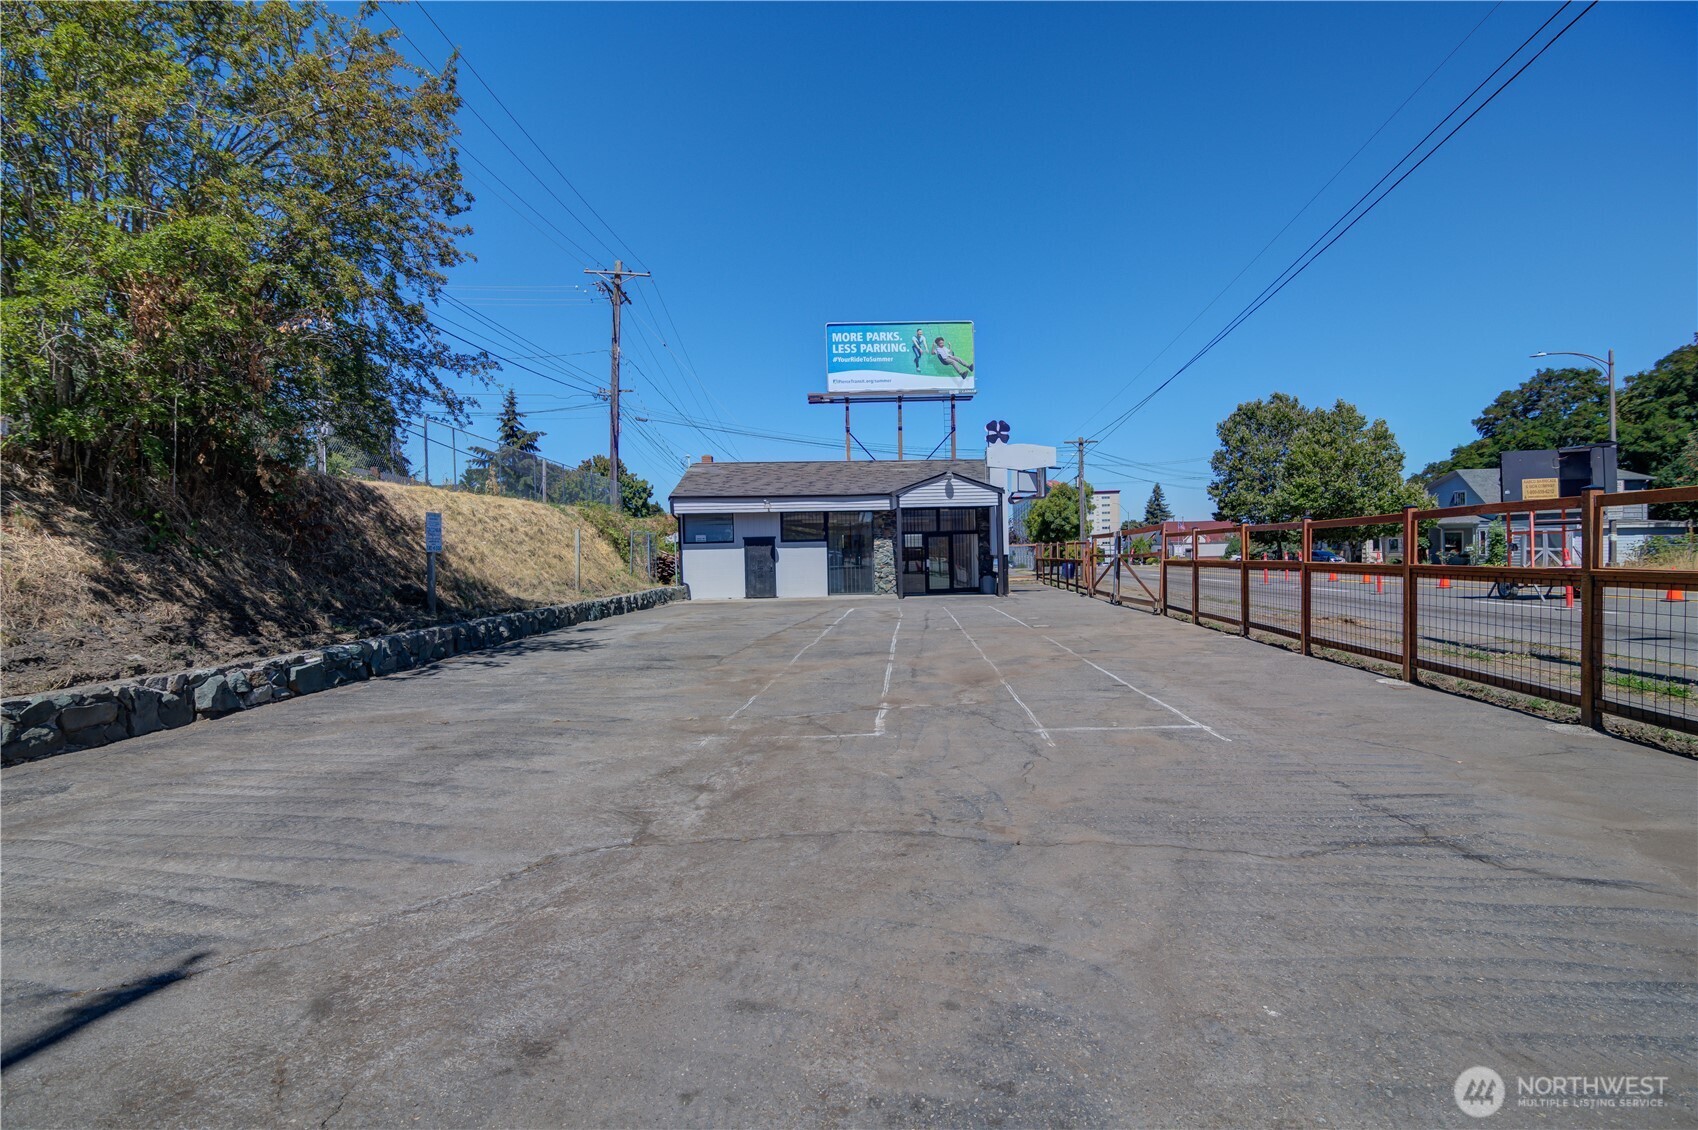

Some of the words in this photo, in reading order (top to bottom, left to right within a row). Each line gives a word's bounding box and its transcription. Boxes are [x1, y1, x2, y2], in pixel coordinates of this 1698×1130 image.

[832, 332, 863, 342] MORE
[866, 332, 902, 341] PARKS.
[832, 344, 857, 354] LESS
[860, 343, 910, 353] PARKING.
